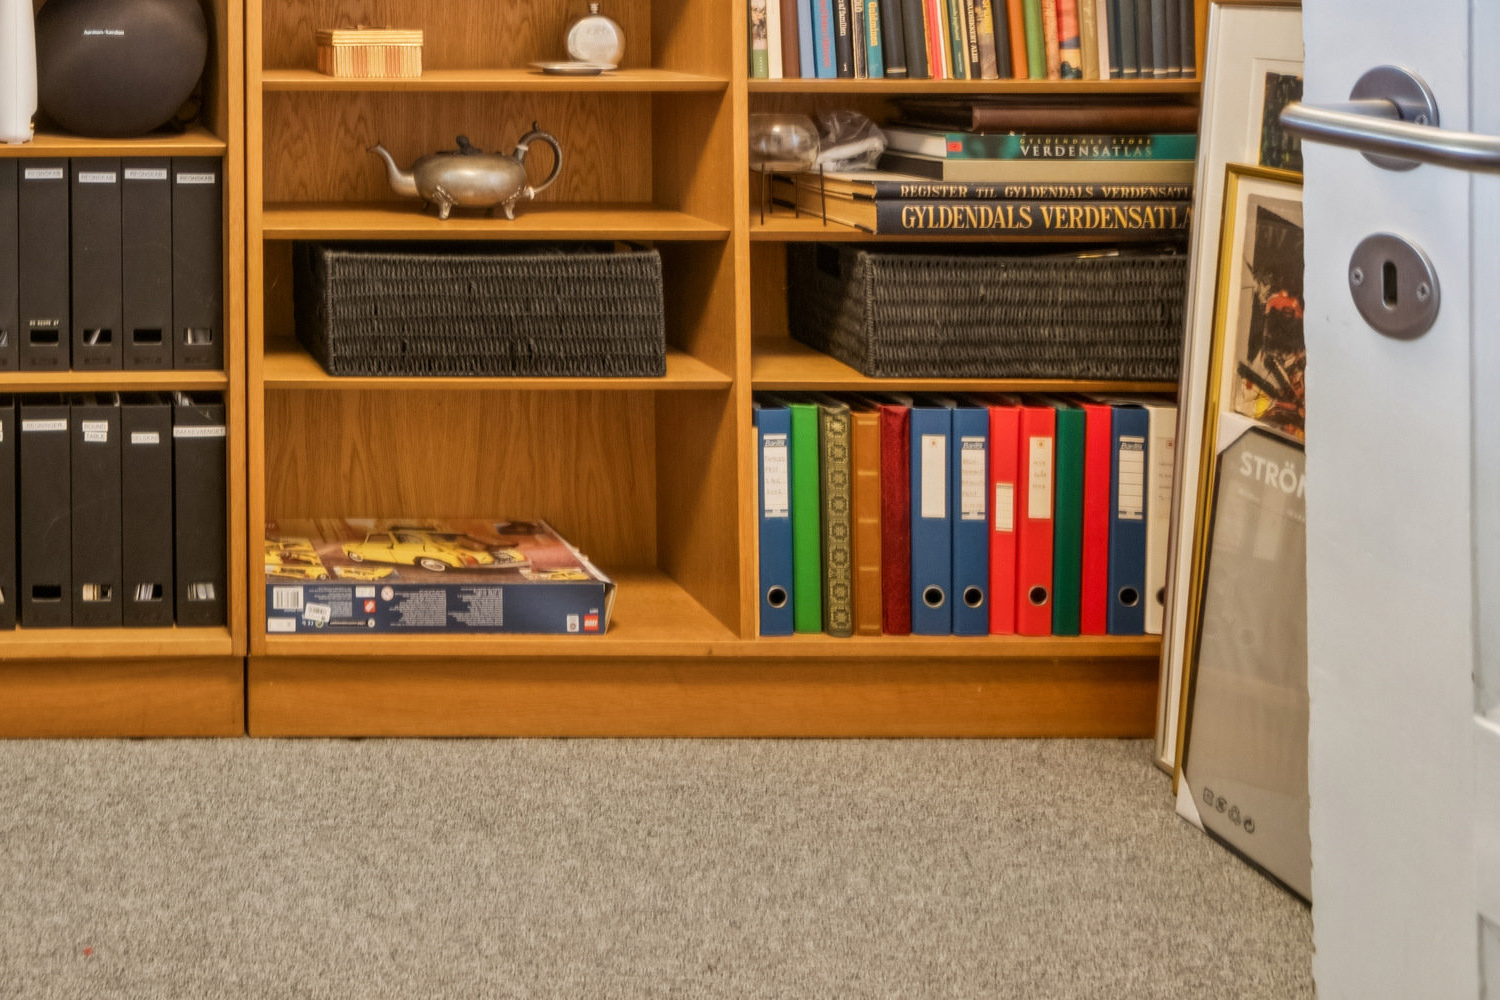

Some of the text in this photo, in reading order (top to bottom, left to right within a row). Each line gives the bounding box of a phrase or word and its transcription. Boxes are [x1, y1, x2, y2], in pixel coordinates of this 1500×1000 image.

[839, 11, 848, 37] familien
[868, 1, 880, 47] Guldminen
[970, 44, 979, 63] ALIBI
[1019, 145, 1152, 158] VERDENSATLAS
[900, 184, 1094, 199] REGISTER TIL GYLDENDALS
[901, 204, 1033, 230] GYLDENDALS
